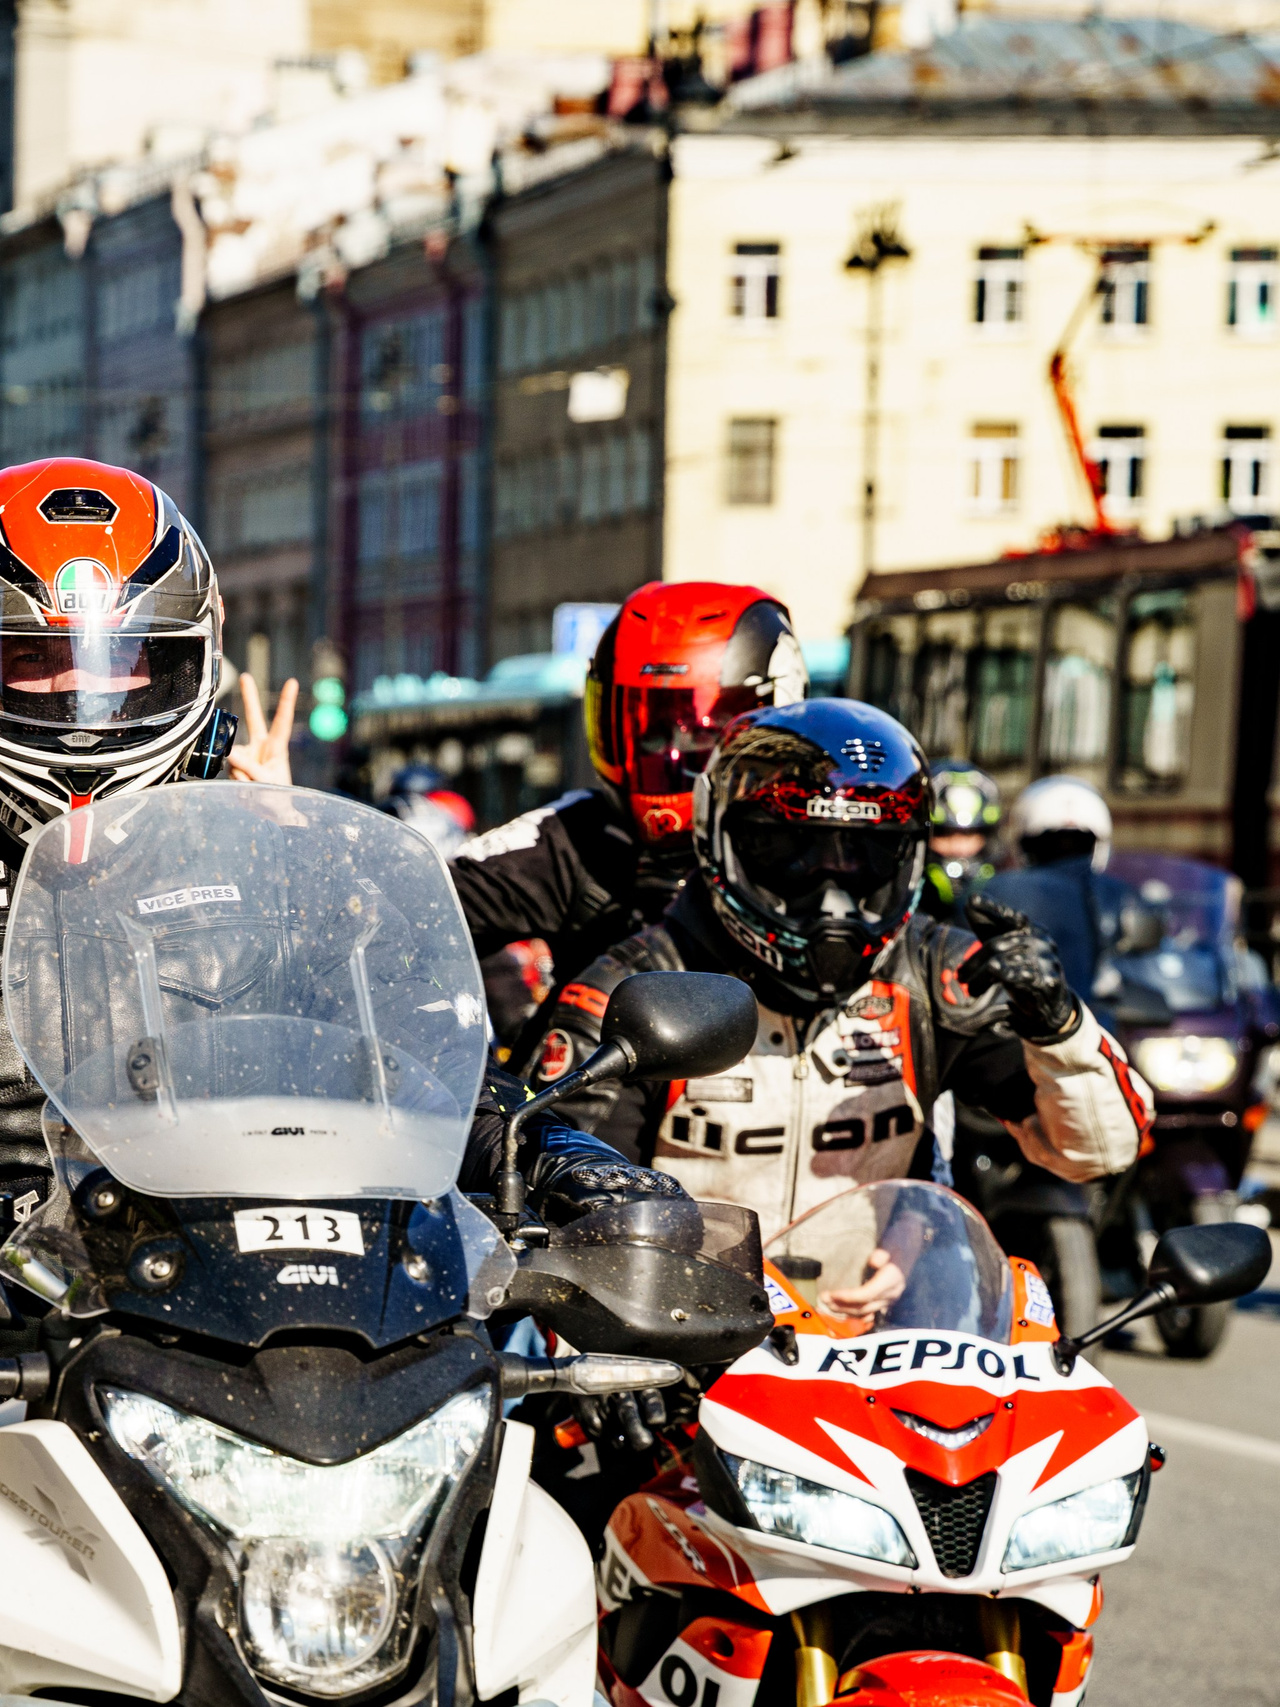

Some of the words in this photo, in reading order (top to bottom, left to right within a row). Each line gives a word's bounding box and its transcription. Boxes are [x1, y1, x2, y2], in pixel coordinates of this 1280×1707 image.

[143, 893, 186, 910] VICE
[190, 888, 234, 901] PRES
[271, 1127, 305, 1136] GIVI
[260, 1214, 341, 1242] 213
[276, 1264, 339, 1286] GIVI
[817, 1339, 1041, 1382] REPSOL
